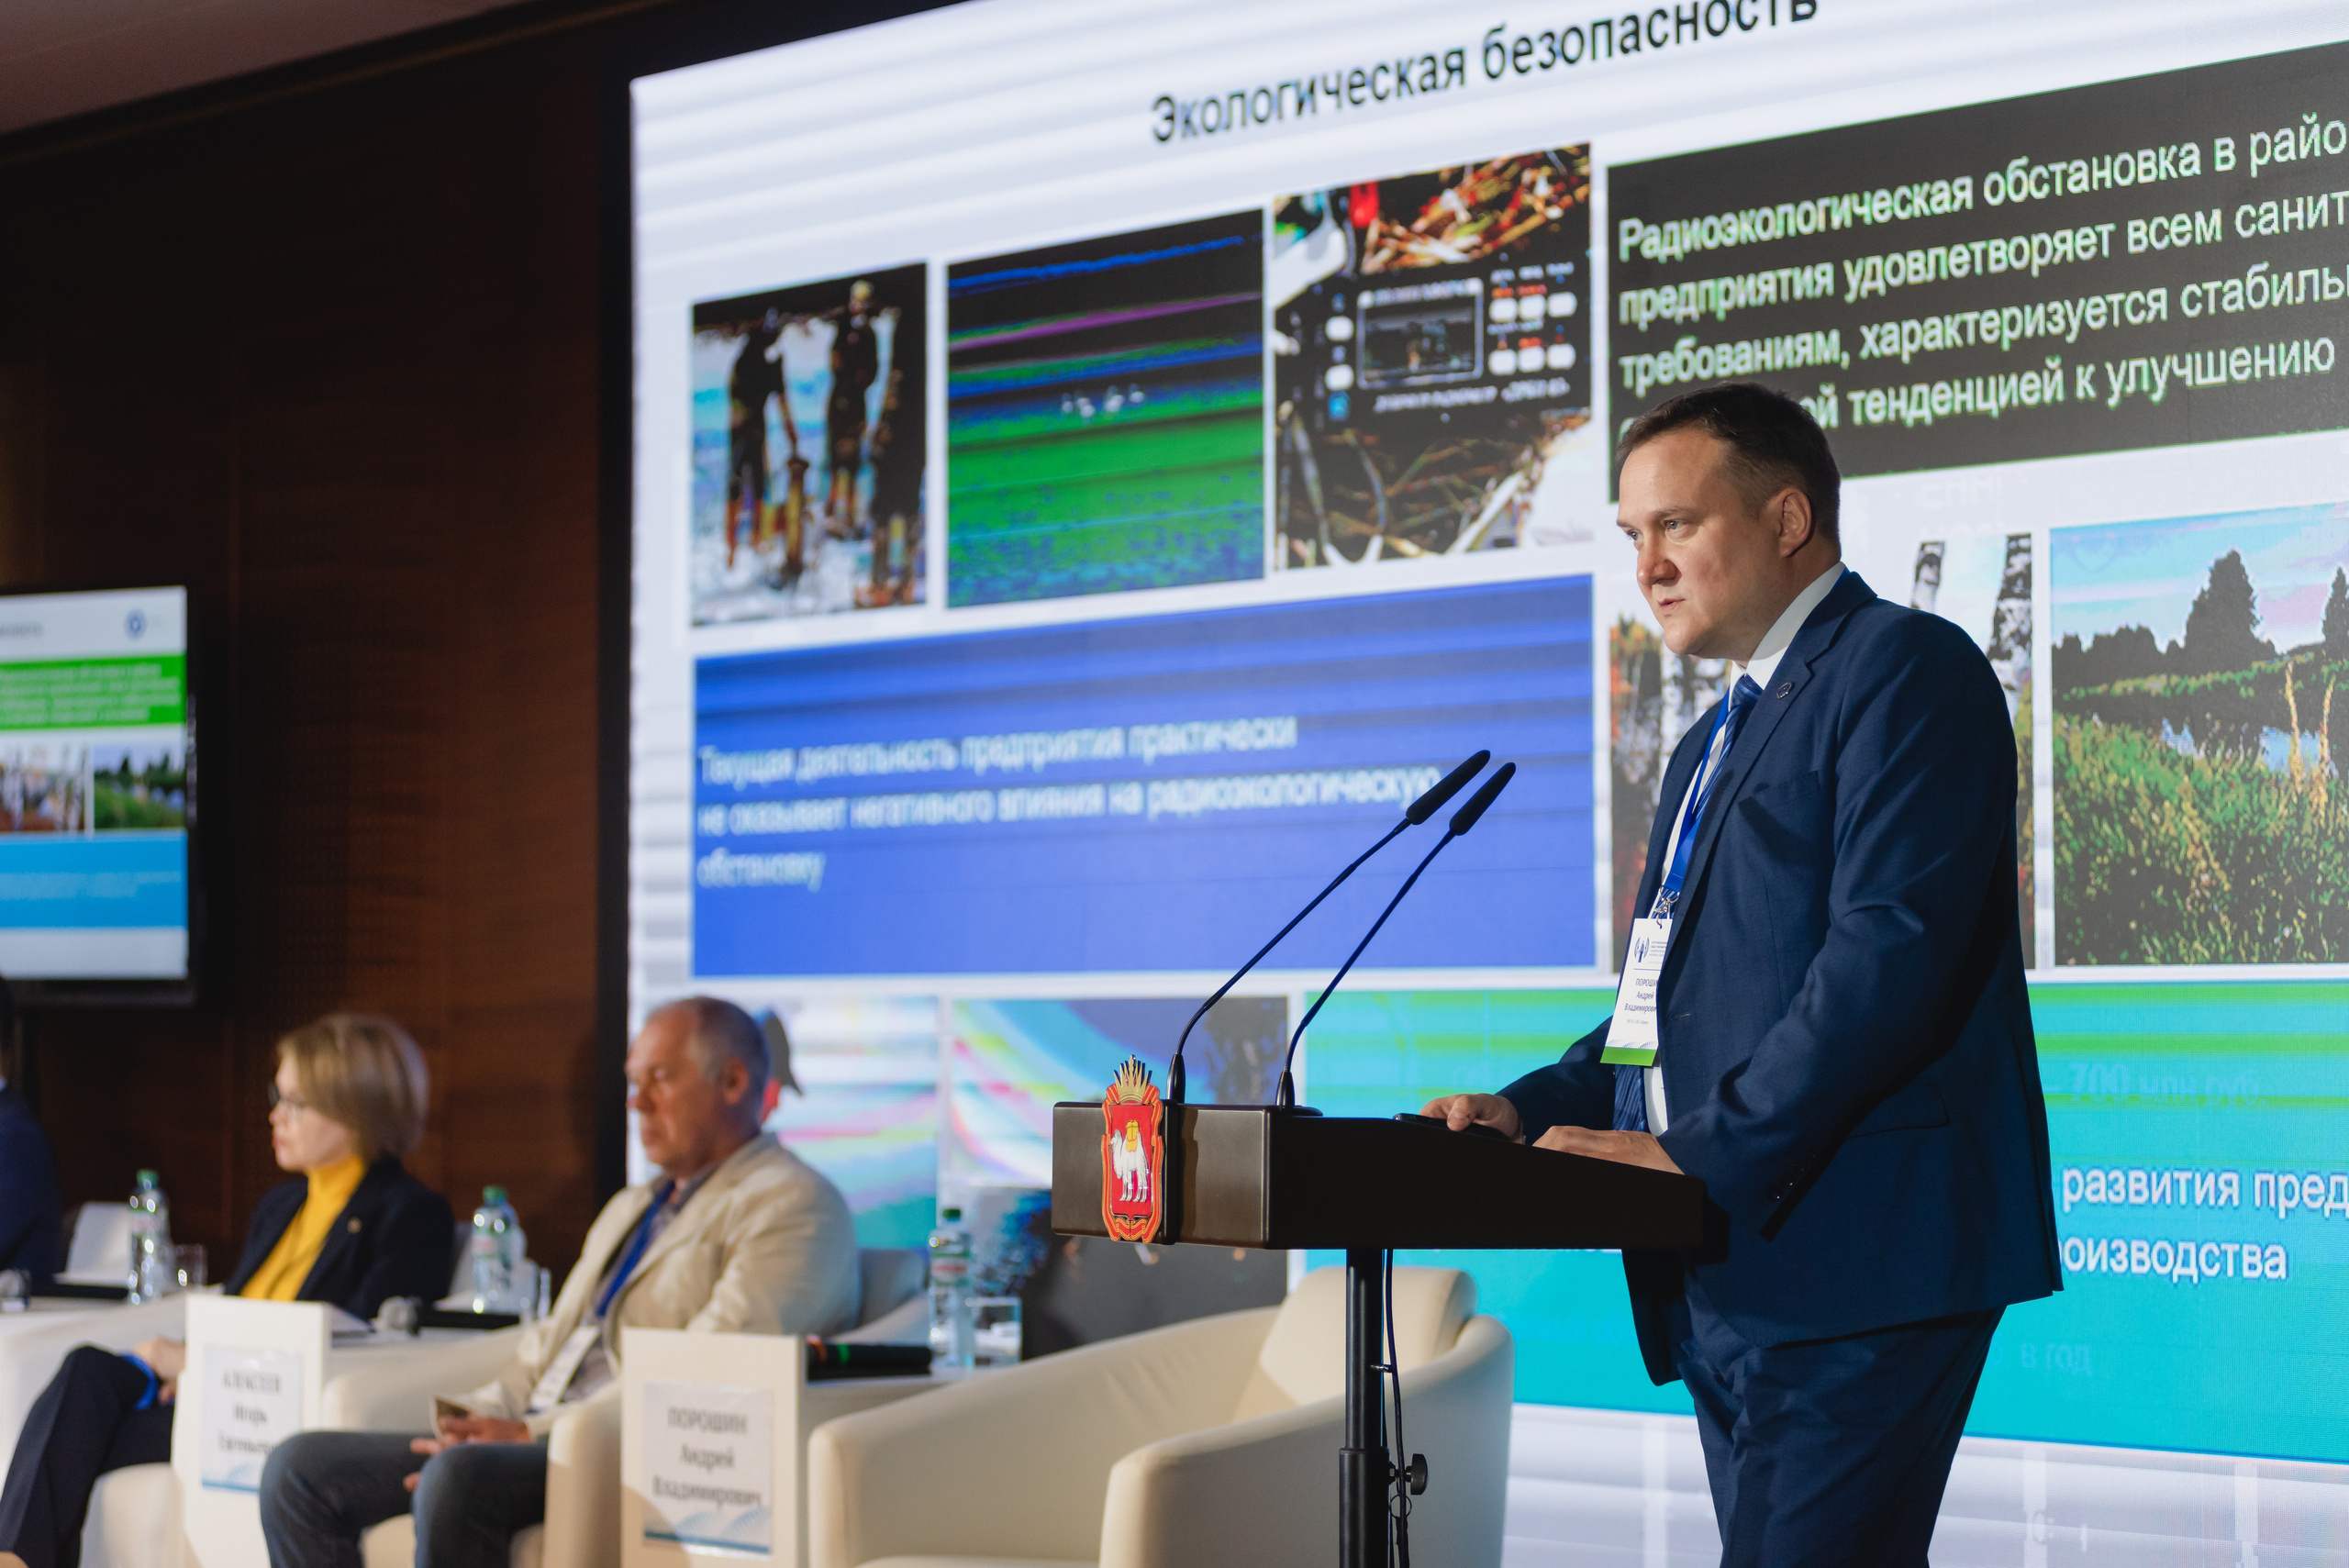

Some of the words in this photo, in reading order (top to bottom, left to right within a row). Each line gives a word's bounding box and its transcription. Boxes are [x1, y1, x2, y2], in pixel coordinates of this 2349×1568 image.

[1152, 47, 1466, 143] Экологическая
[1483, 0, 1818, 80] безопасность
[1618, 175, 1974, 262] Радиоэкологическая
[1983, 141, 2201, 206] обстановка
[2214, 137, 2236, 172] в
[2250, 112, 2348, 178] райо
[1619, 262, 1834, 332] предприятия
[1842, 223, 2116, 304] удовлетворяет
[2127, 207, 2222, 254] всем
[2234, 190, 2349, 239] санит
[1618, 328, 1850, 399] требованиям,
[1858, 286, 2168, 364] характеризуется
[2179, 261, 2349, 318] стабиль
[1846, 355, 2065, 427] тенденцией
[2076, 362, 2097, 400] к
[2105, 336, 2335, 409] улучшению
[962, 726, 1126, 776] предприятия
[1128, 716, 1297, 766] практически
[2063, 1167, 2239, 1213] развития
[2254, 1173, 2349, 1218] пред
[2058, 1237, 2288, 1284] оизводства
[668, 1406, 747, 1434] ПОРОШИН
